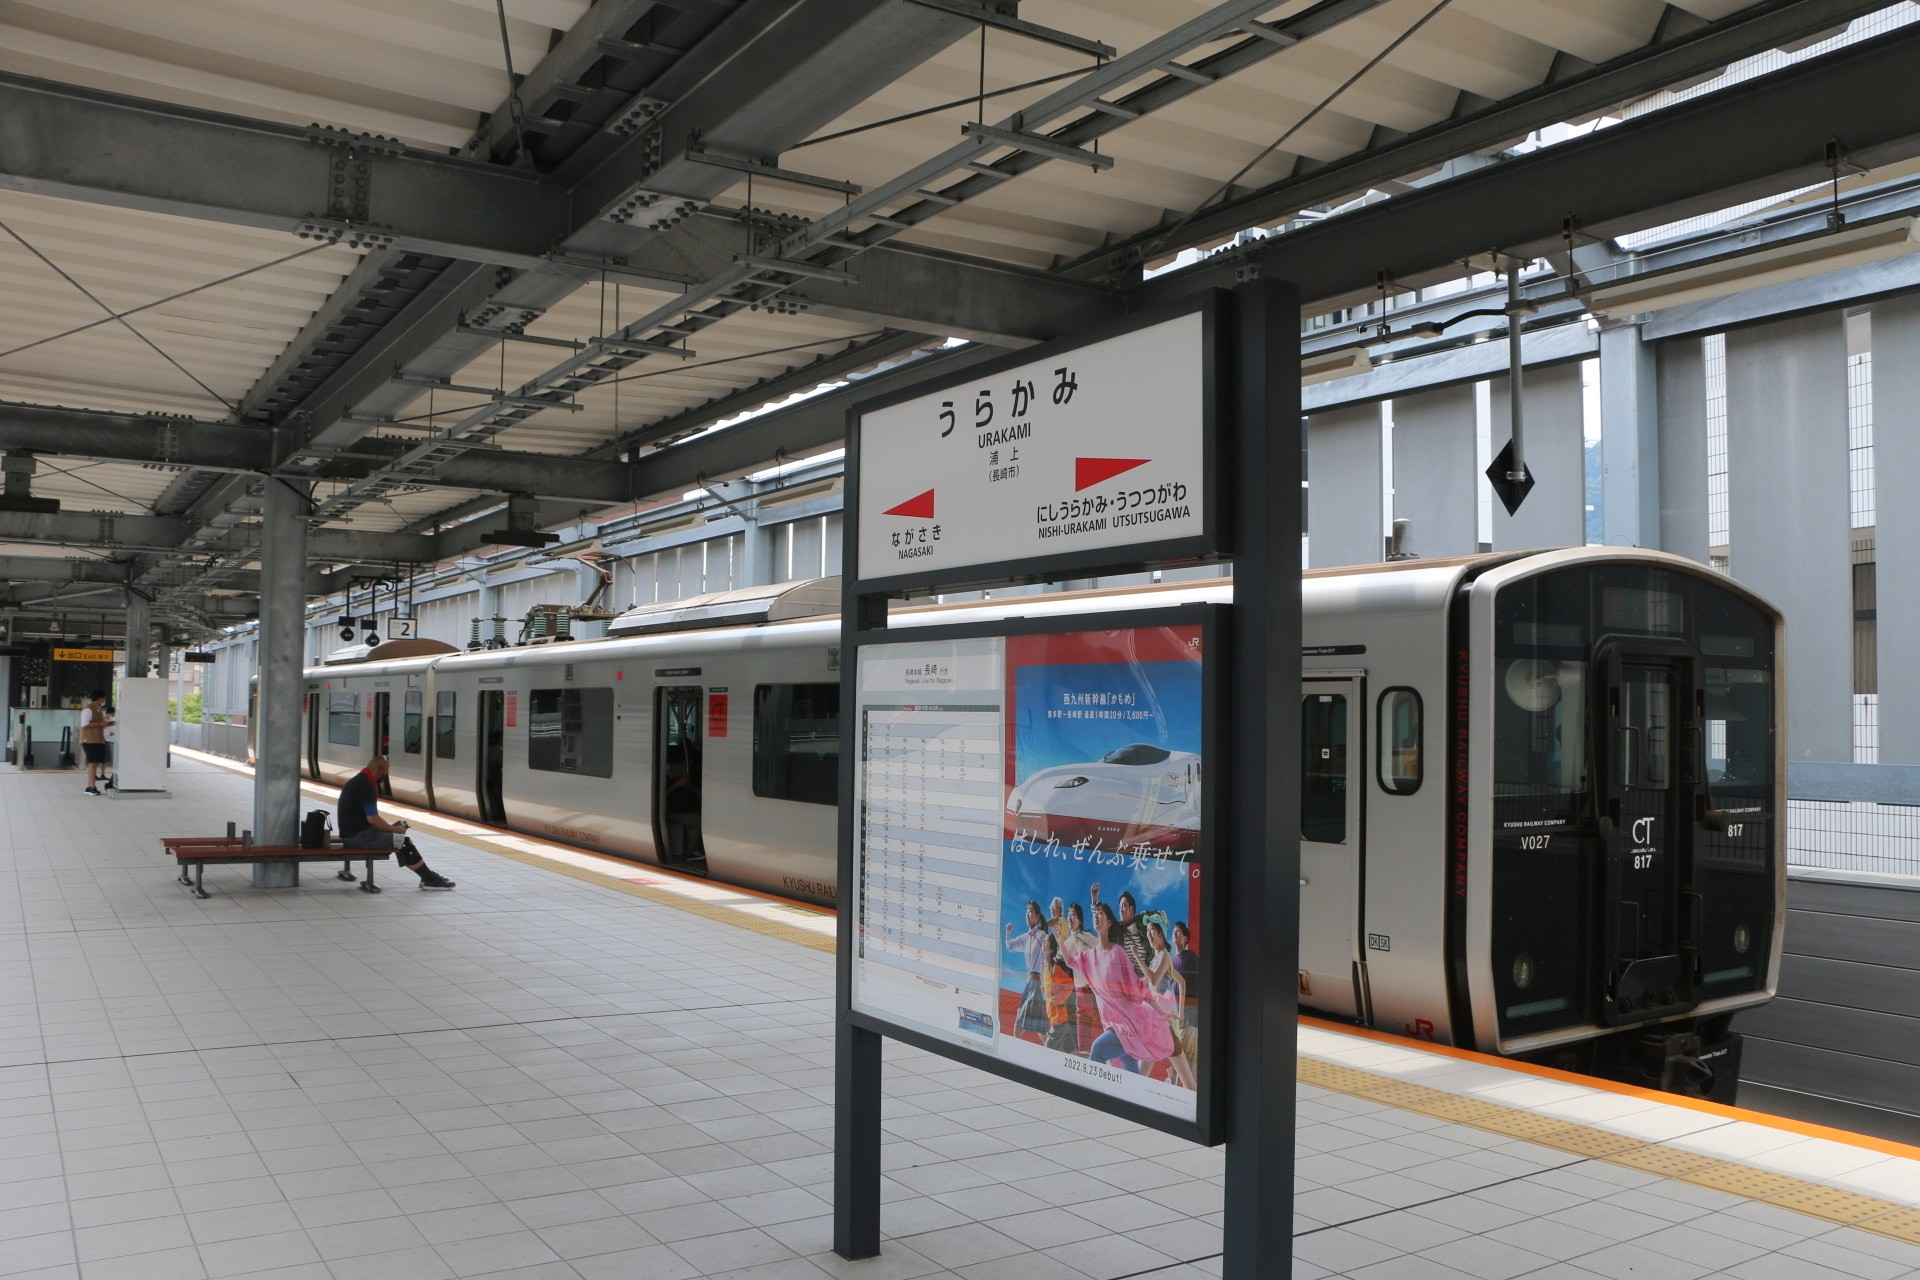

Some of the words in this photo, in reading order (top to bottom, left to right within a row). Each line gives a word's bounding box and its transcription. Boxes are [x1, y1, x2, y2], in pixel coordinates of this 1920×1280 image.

[939, 367, 1078, 438] うらかみ
[978, 422, 1031, 449] URAKAMI
[989, 446, 1019, 466] 浦上
[1038, 517, 1107, 539] NISHI-URAKAMI
[1112, 505, 1191, 528] UTSUTSUGAWA
[891, 524, 942, 547] ながさき
[898, 545, 934, 560] NAGASAKI
[400, 622, 410, 636] 2
[1188, 637, 1200, 647] JR
[924, 664, 938, 676] 長崎
[1457, 651, 1469, 721] KYUSHU
[1063, 693, 1135, 706] 西九州新幹線「かもめ」
[1457, 729, 1469, 804] RAILWAY
[1632, 817, 1655, 844] CT
[1728, 824, 1743, 837] 817
[1521, 835, 1550, 850] V027
[1455, 812, 1467, 897] COMPANY
[1634, 855, 1652, 869] 817
[782, 876, 815, 894] KYUSHU
[1405, 1018, 1434, 1040] JR
[1064, 1057, 1098, 1076] 2022.9.23
[1098, 1067, 1122, 1084] Debut!
